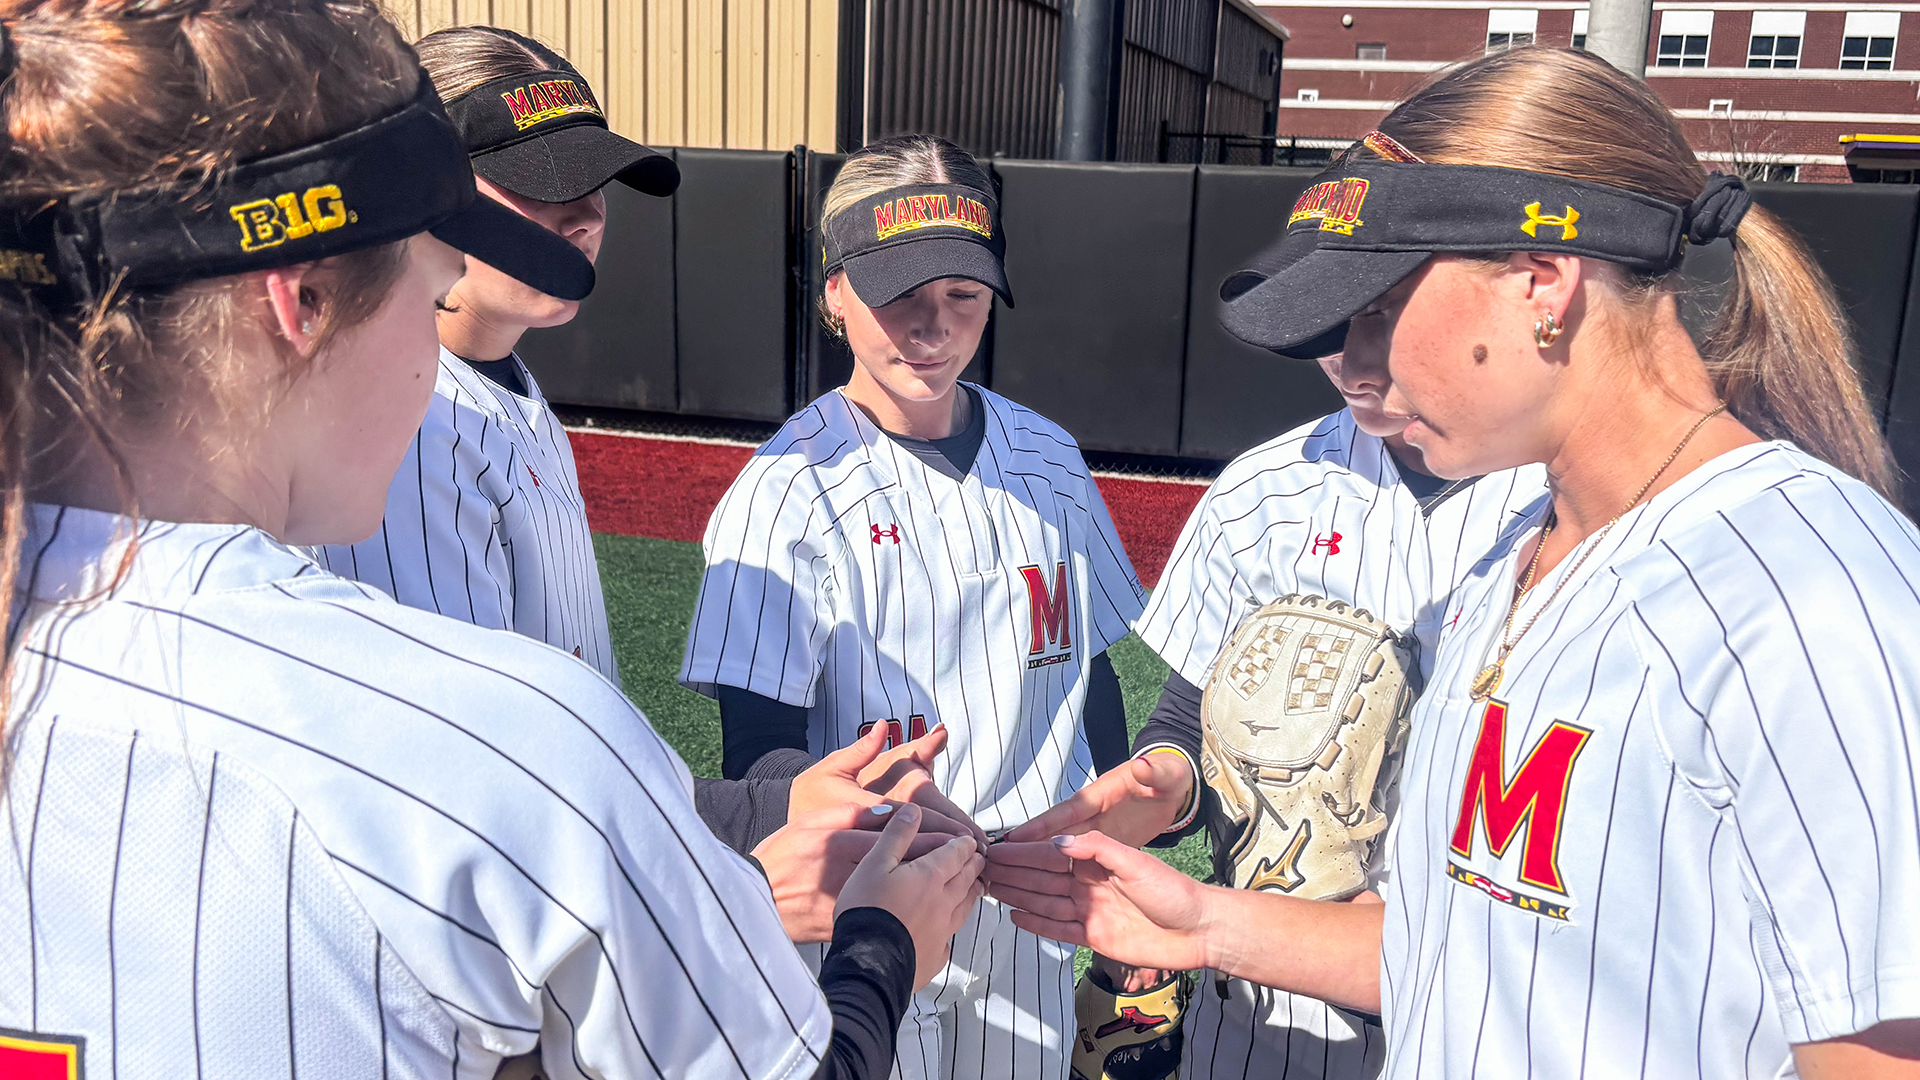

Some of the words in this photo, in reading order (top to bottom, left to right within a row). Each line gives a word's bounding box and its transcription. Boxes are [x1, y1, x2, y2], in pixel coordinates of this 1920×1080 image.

[874, 195, 992, 236] MARYLAND
[1017, 562, 1071, 655] M
[1448, 697, 1594, 898] M
